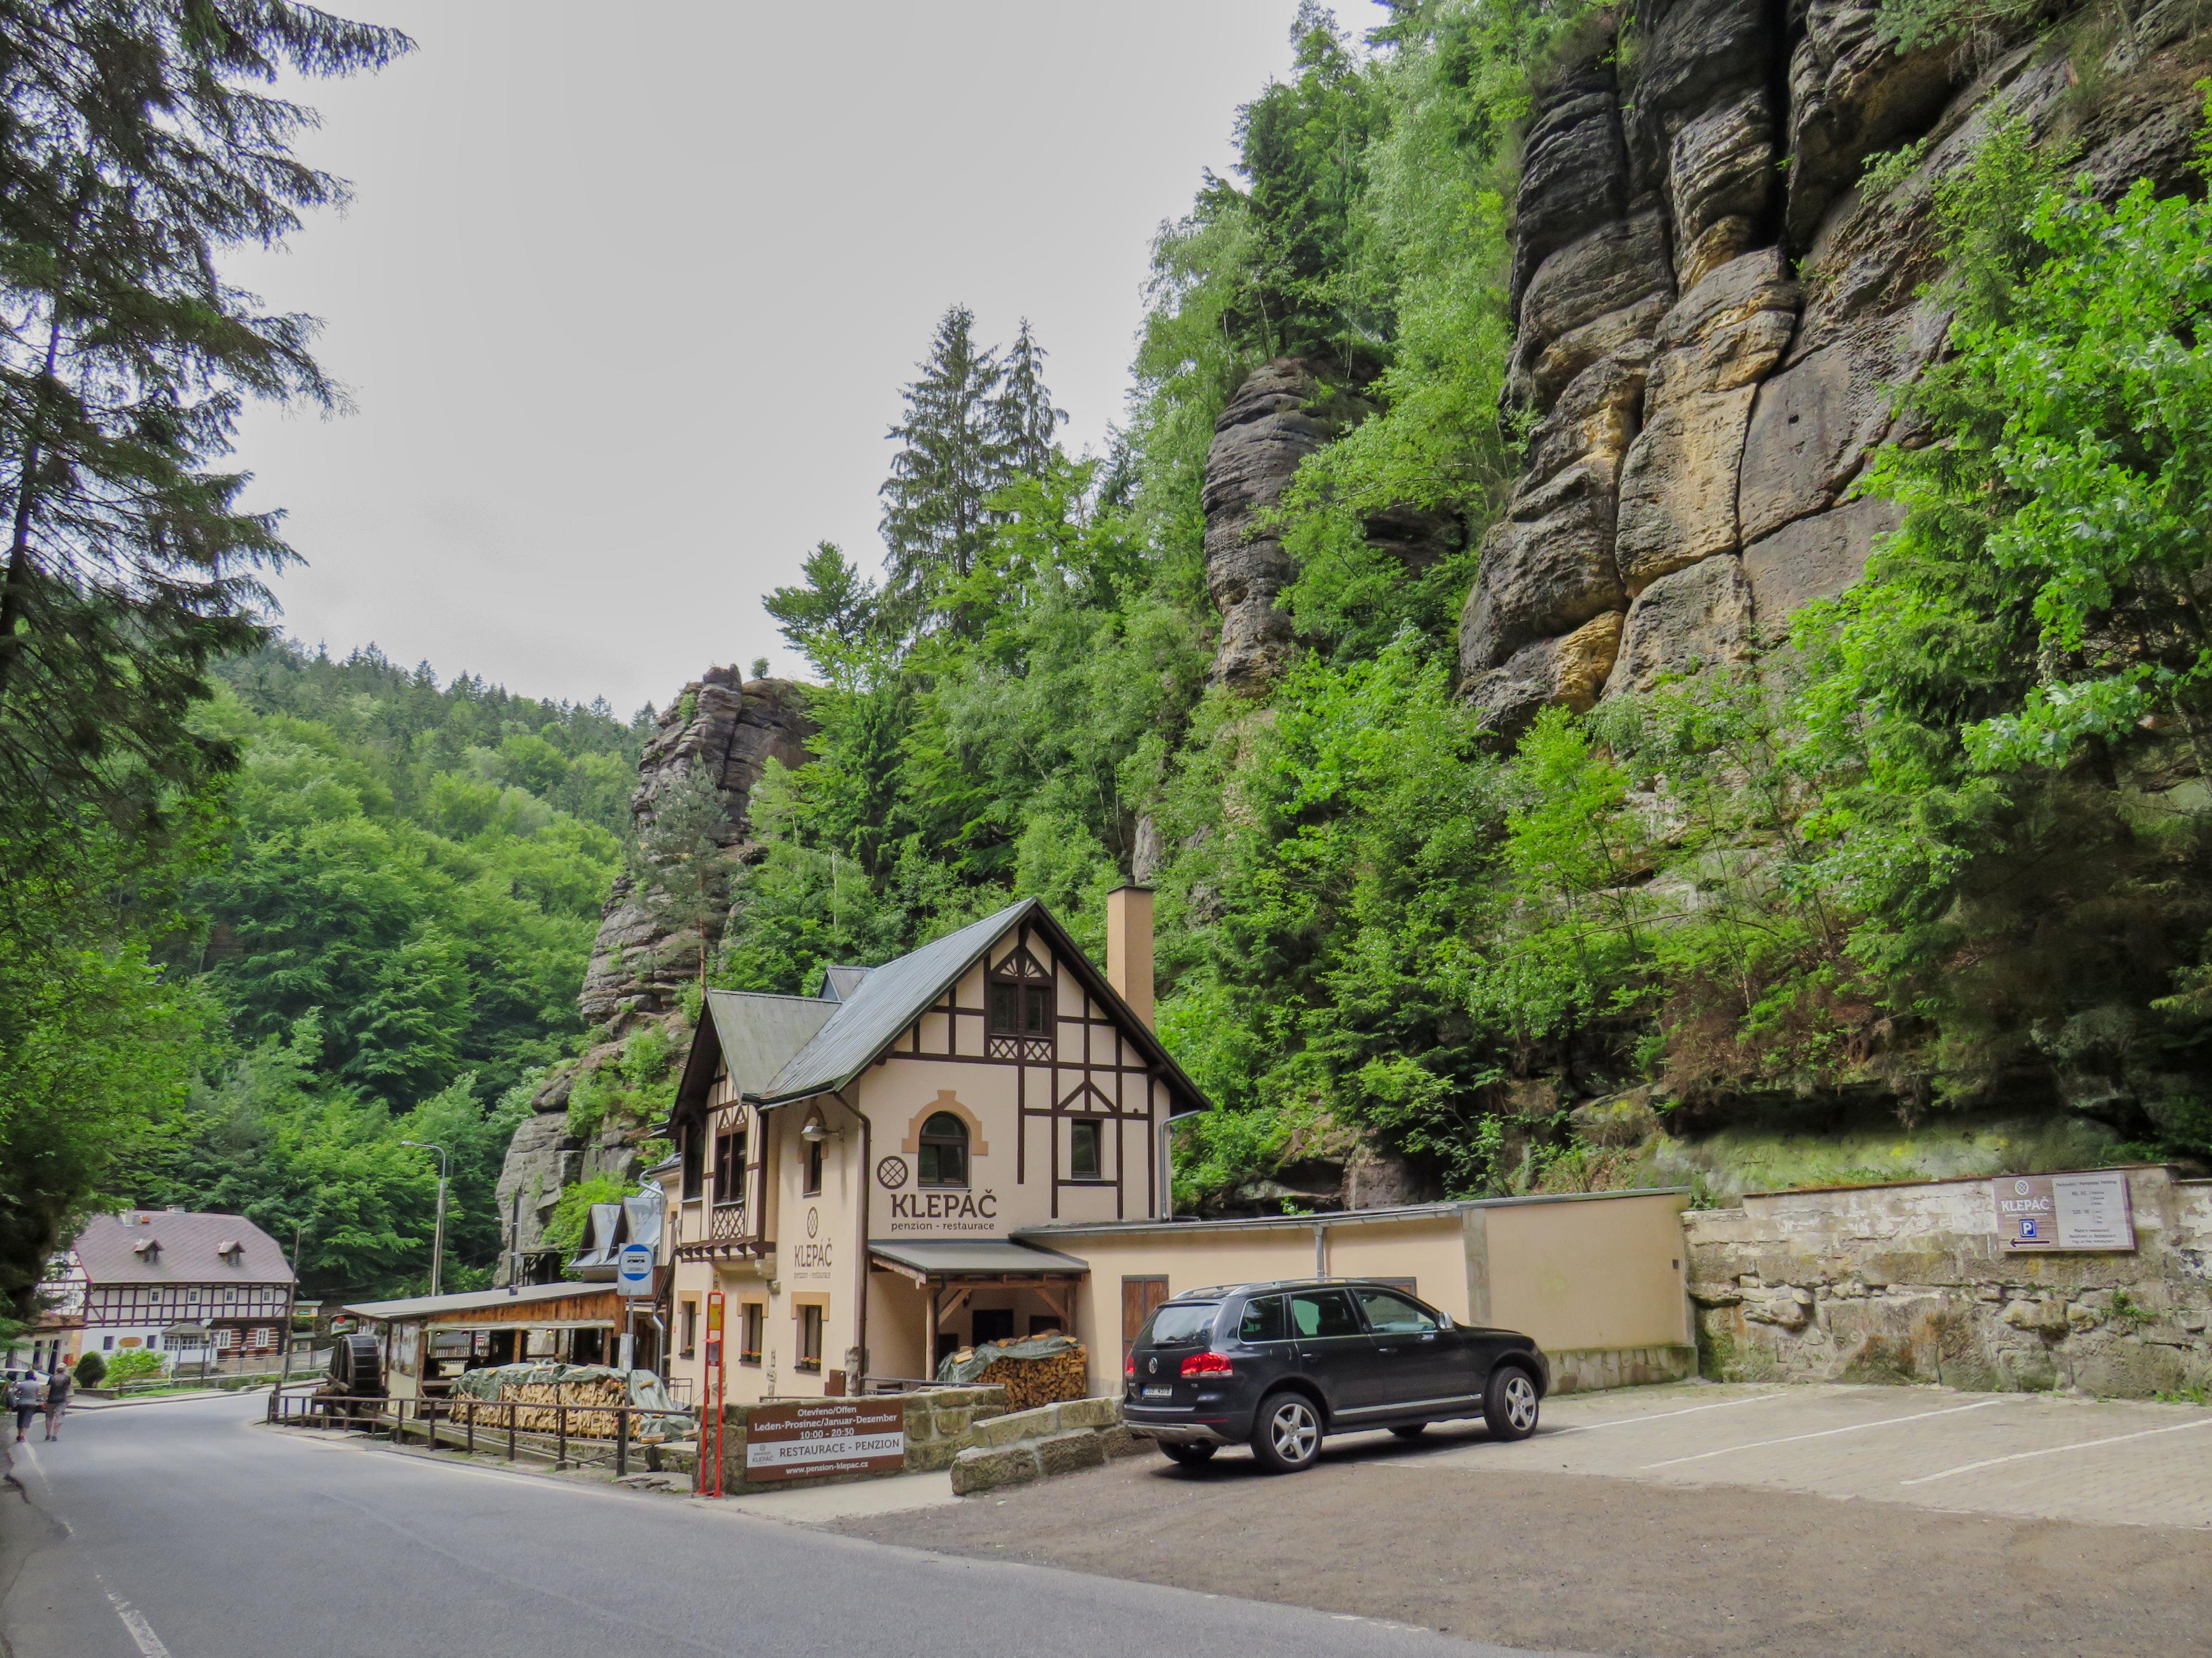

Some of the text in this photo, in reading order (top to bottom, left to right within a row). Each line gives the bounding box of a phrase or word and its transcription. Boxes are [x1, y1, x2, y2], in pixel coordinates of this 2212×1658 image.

[890, 1189, 997, 1218] KLEPÁČ
[2001, 1196, 2049, 1212] KLEPÁČ
[891, 1221, 932, 1232] penzion
[943, 1221, 994, 1230] restaurace
[2023, 1222, 2032, 1235] P
[795, 1237, 832, 1267] KLEPÁČ
[754, 1414, 898, 1431] Leden-Prosinec/Januar-Dezember
[800, 1430, 823, 1440] 10:00
[831, 1427, 854, 1437] 20:30
[780, 1443, 846, 1458] RESTAURACE
[855, 1439, 899, 1451] PENZION
[786, 1461, 868, 1476] www.pension-klepac.cz
